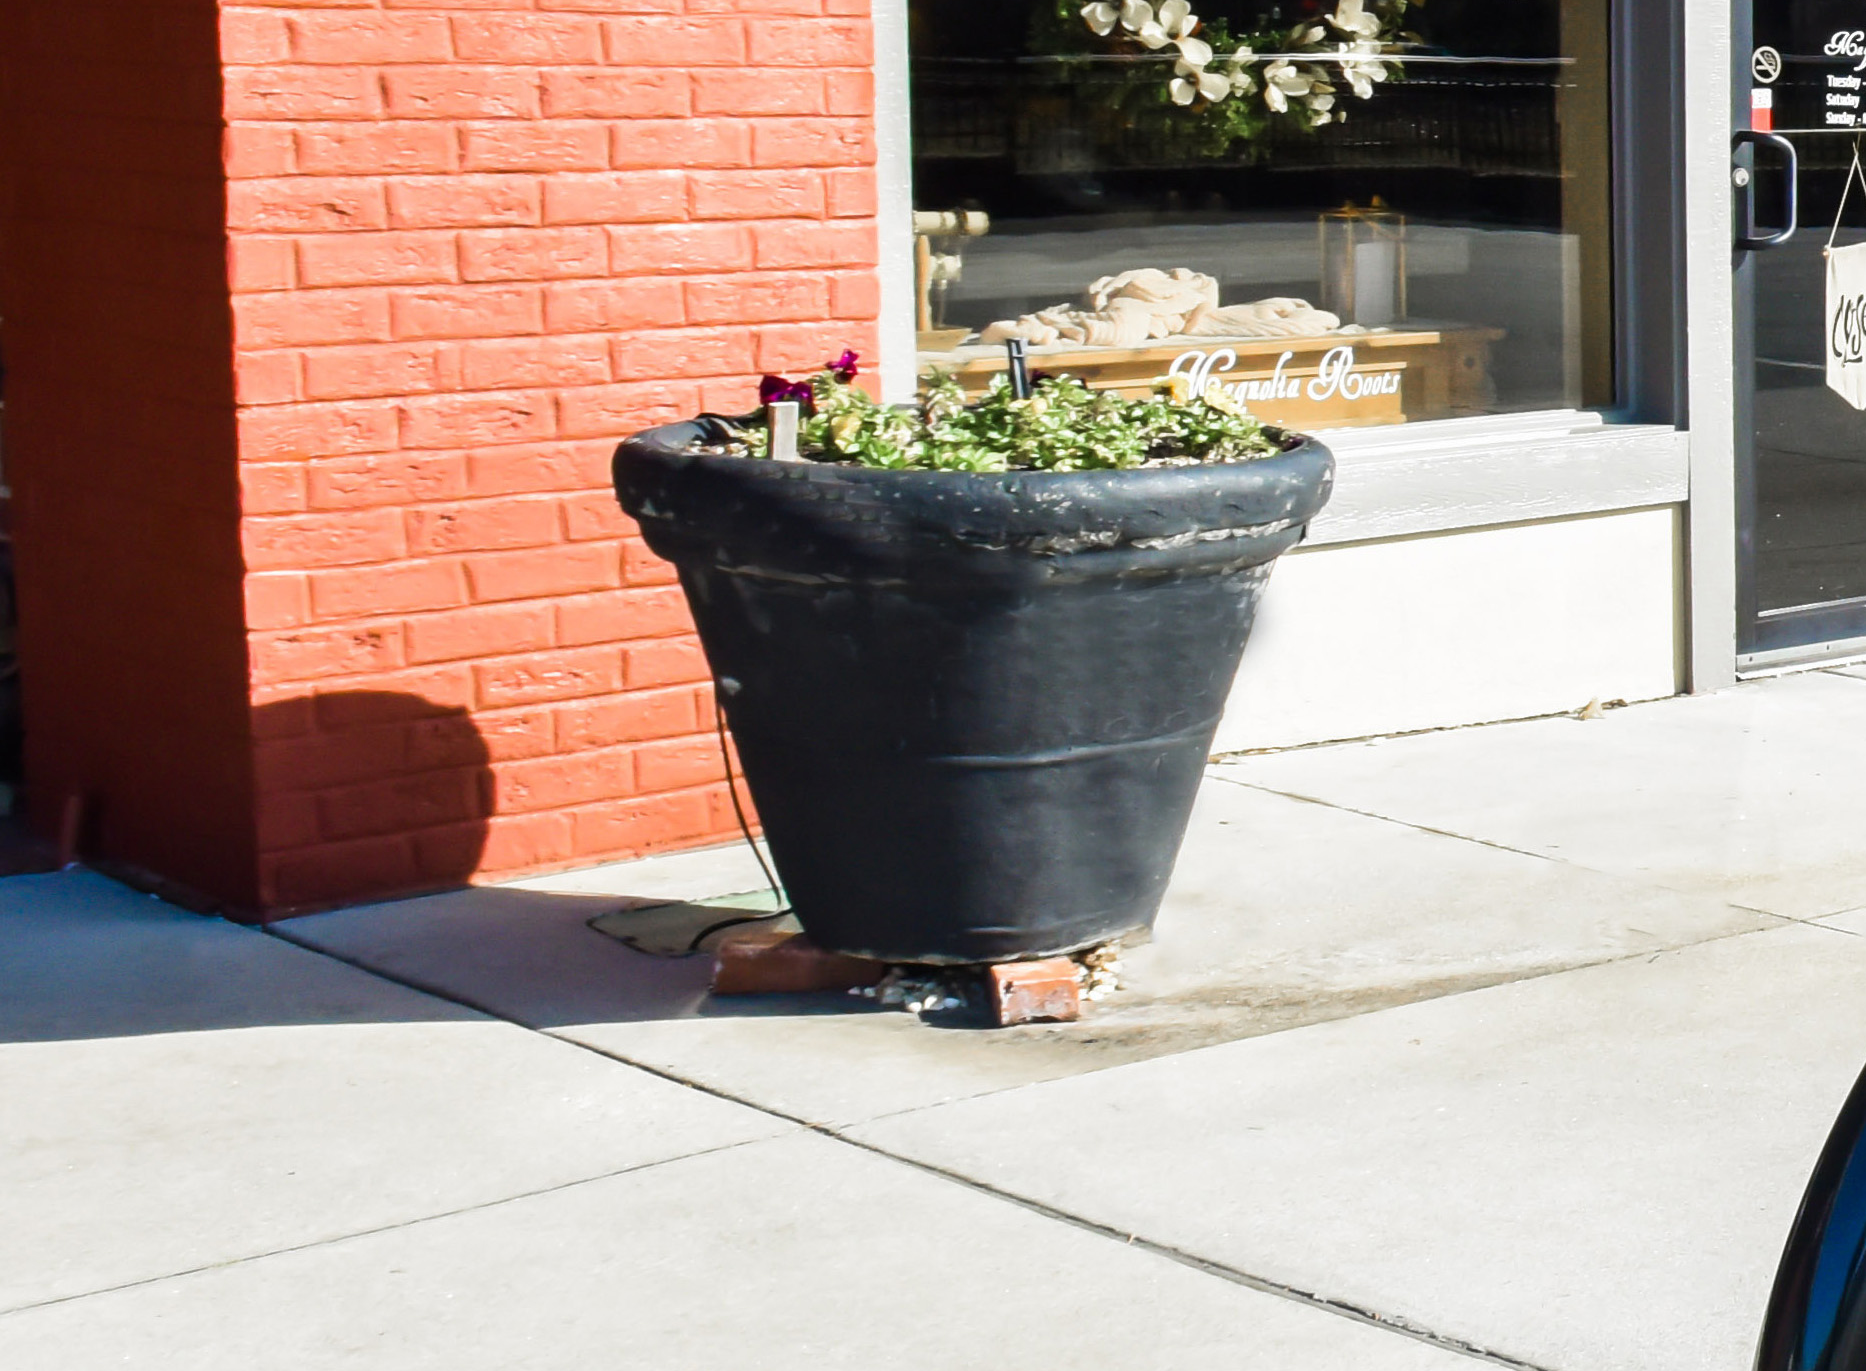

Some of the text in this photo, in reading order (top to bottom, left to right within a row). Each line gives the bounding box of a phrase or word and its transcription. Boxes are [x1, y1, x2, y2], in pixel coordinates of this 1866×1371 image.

[1827, 75, 1861, 90] Tuesday
[1826, 112, 1856, 127] Sunday
[1307, 346, 1400, 400] Roots
